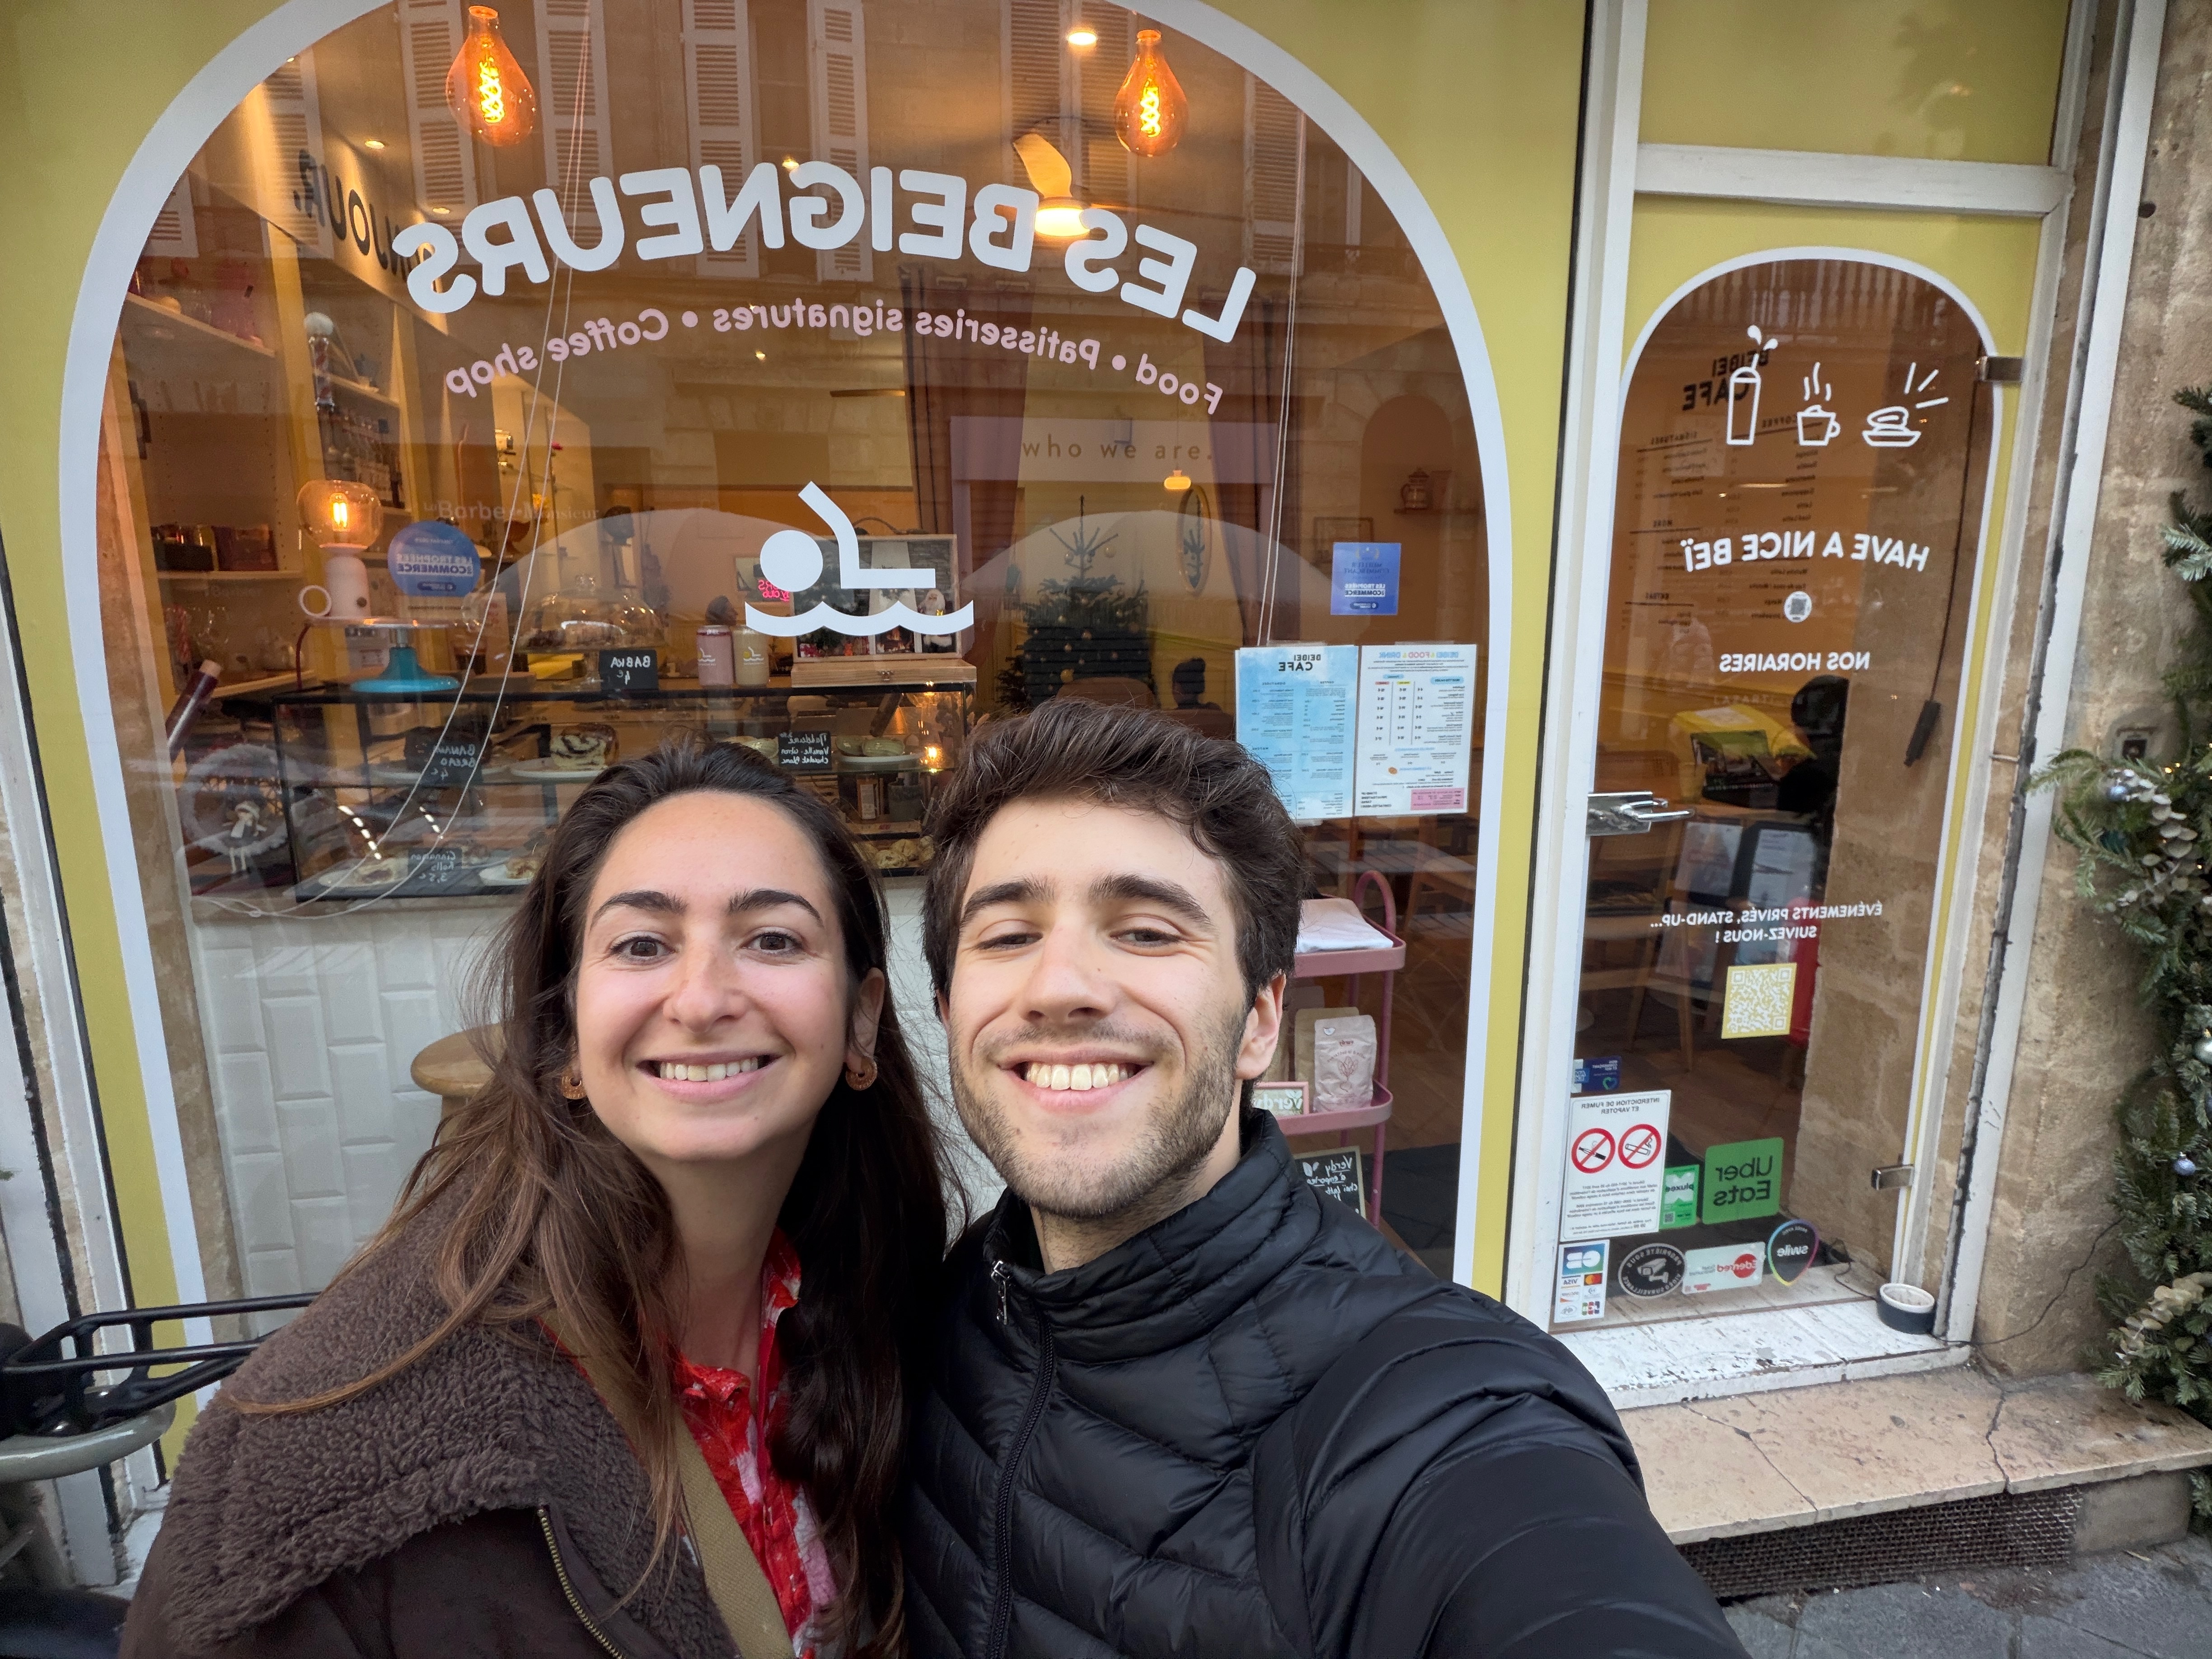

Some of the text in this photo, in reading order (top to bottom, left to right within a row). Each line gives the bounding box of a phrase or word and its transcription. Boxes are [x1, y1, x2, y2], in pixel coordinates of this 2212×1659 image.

[1022, 434, 1212, 460] who we are.
